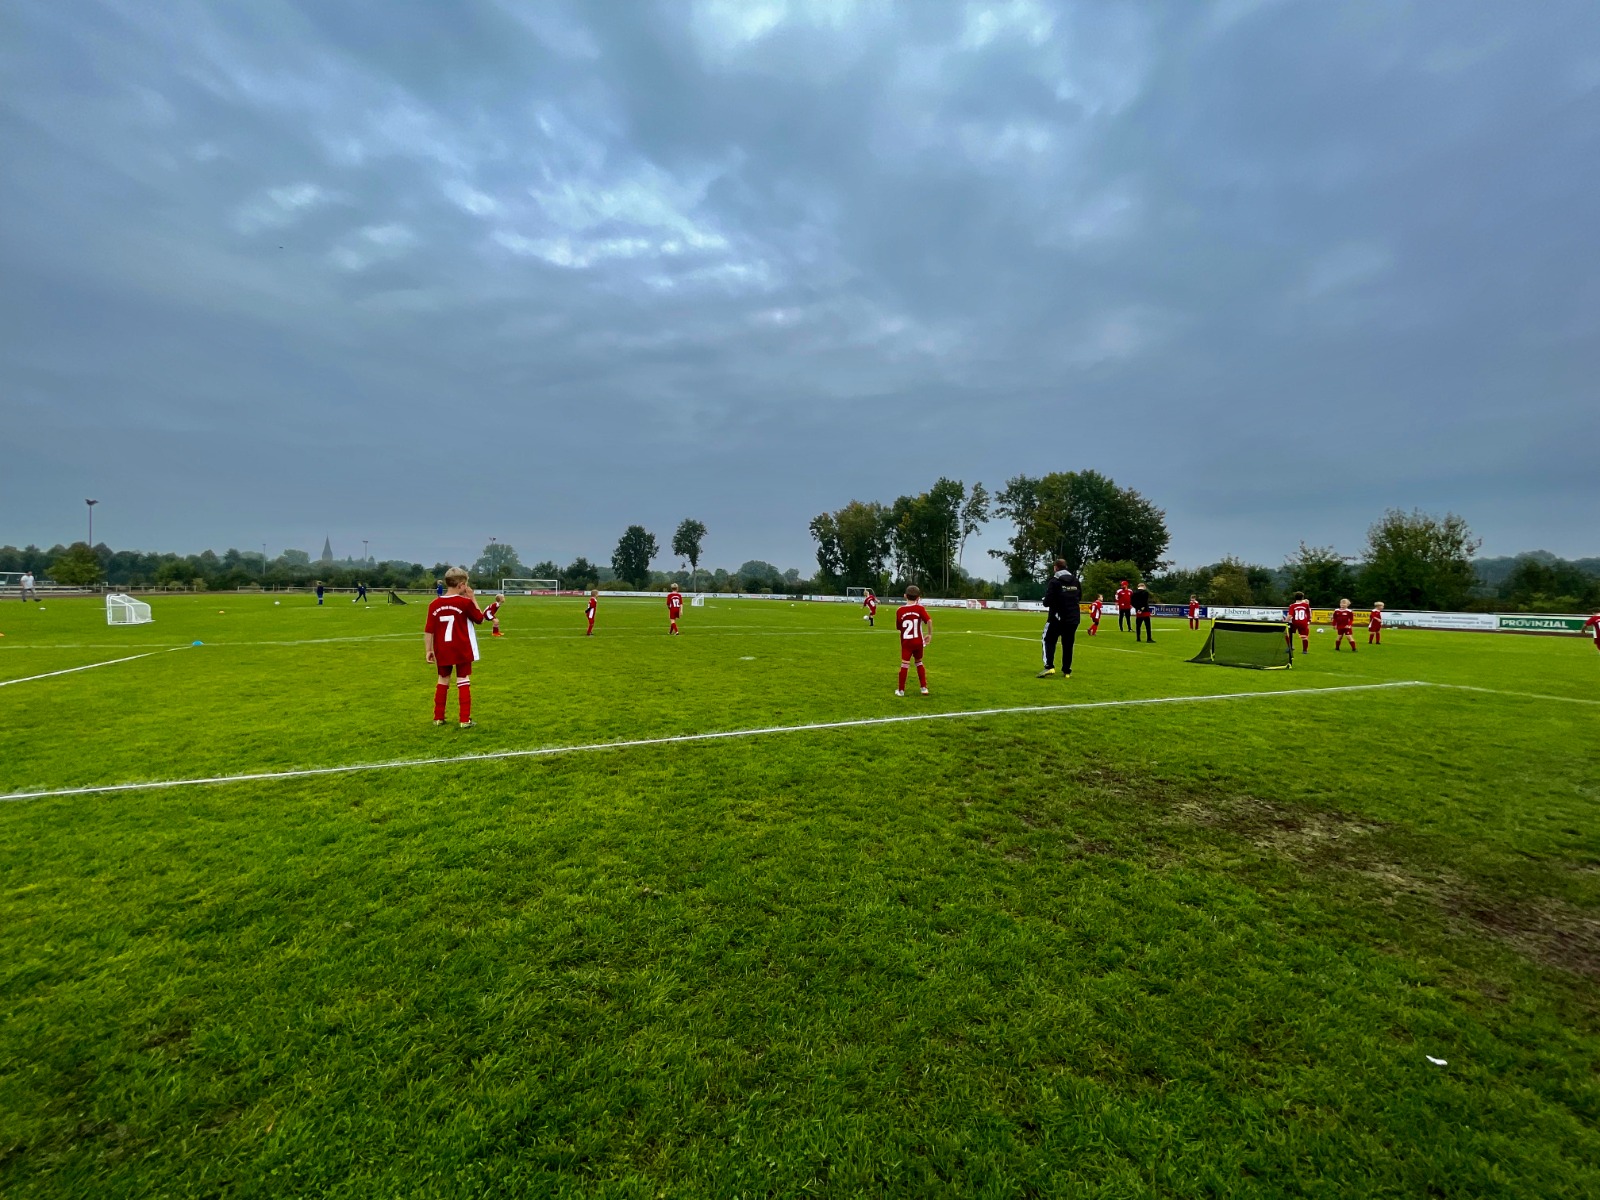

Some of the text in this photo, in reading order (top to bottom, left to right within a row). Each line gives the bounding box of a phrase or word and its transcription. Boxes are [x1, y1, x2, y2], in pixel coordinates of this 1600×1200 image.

[672, 598, 680, 608] 12
[1295, 610, 1305, 620] 10
[440, 614, 455, 642] 7
[1502, 619, 1569, 628] PROVINZIAL
[902, 618, 918, 640] 21
